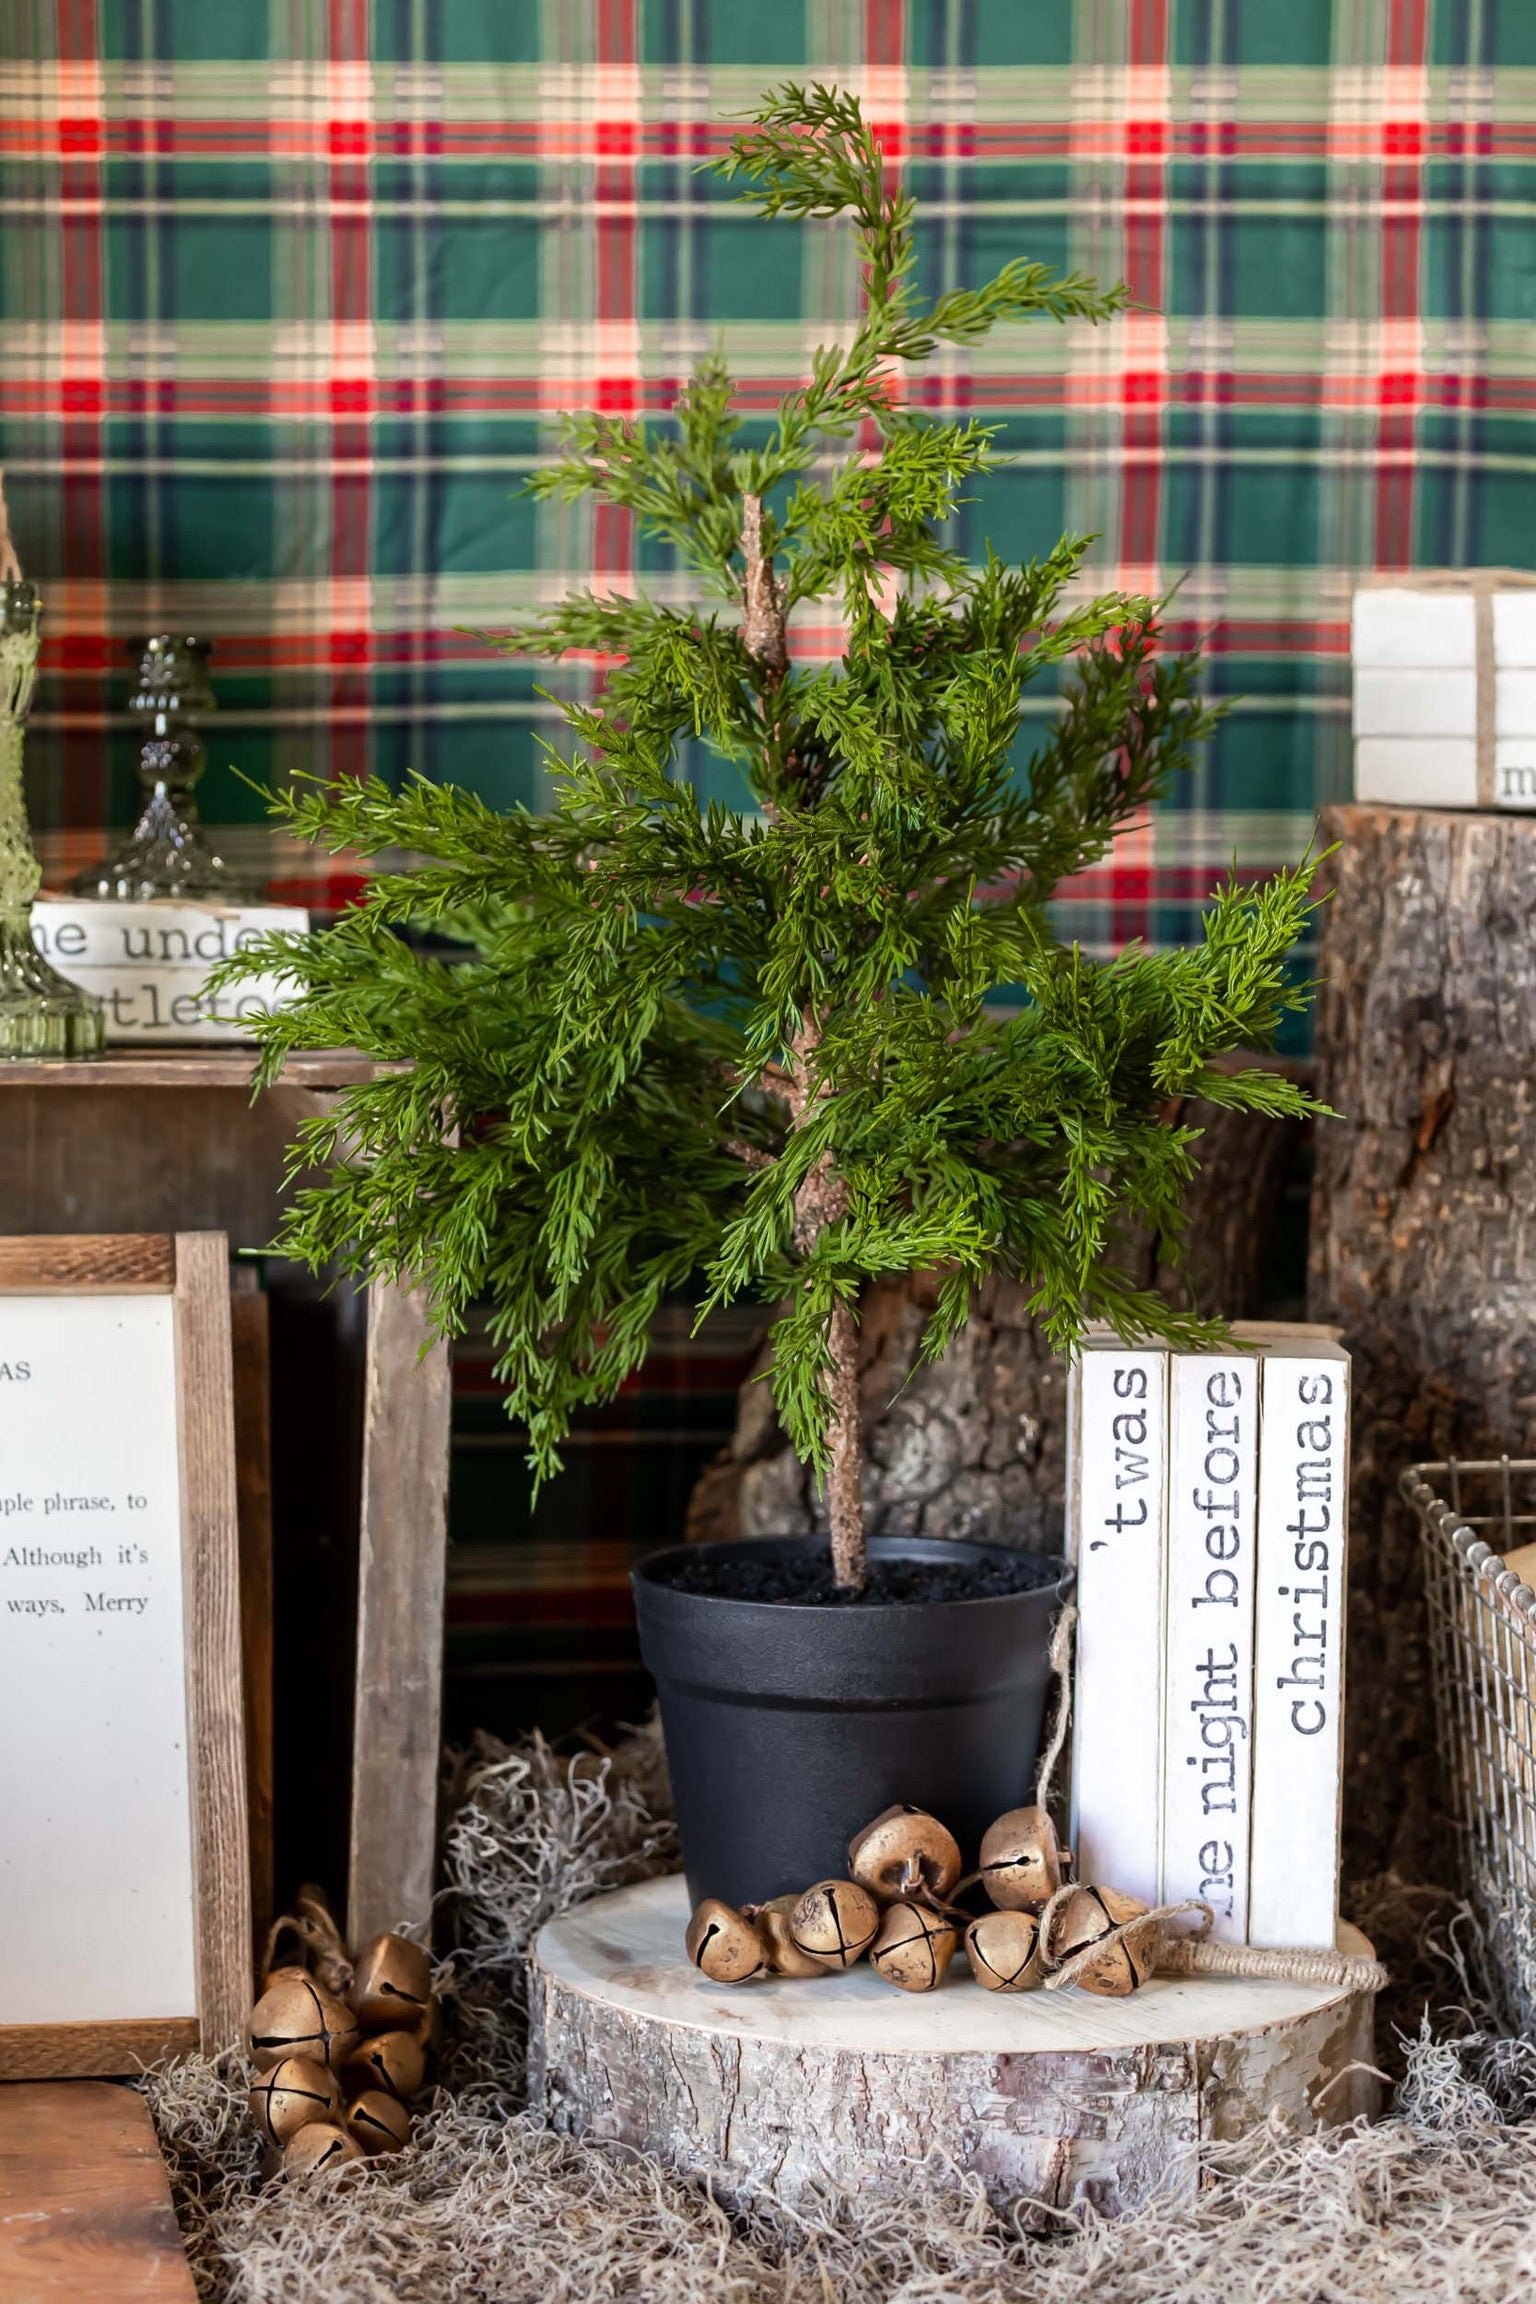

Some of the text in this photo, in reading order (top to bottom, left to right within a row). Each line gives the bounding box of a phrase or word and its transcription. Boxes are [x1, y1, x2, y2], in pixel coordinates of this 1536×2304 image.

[122, 916, 306, 960] unde
[1090, 1369, 1148, 1551] 'twas
[0, 1492, 148, 1516] ple phrase, to
[3, 1543, 149, 1569] Although it's
[1277, 1374, 1333, 1736] christmas
[7, 1591, 149, 1618] ways, Merry
[1184, 1371, 1247, 1934] he night before
